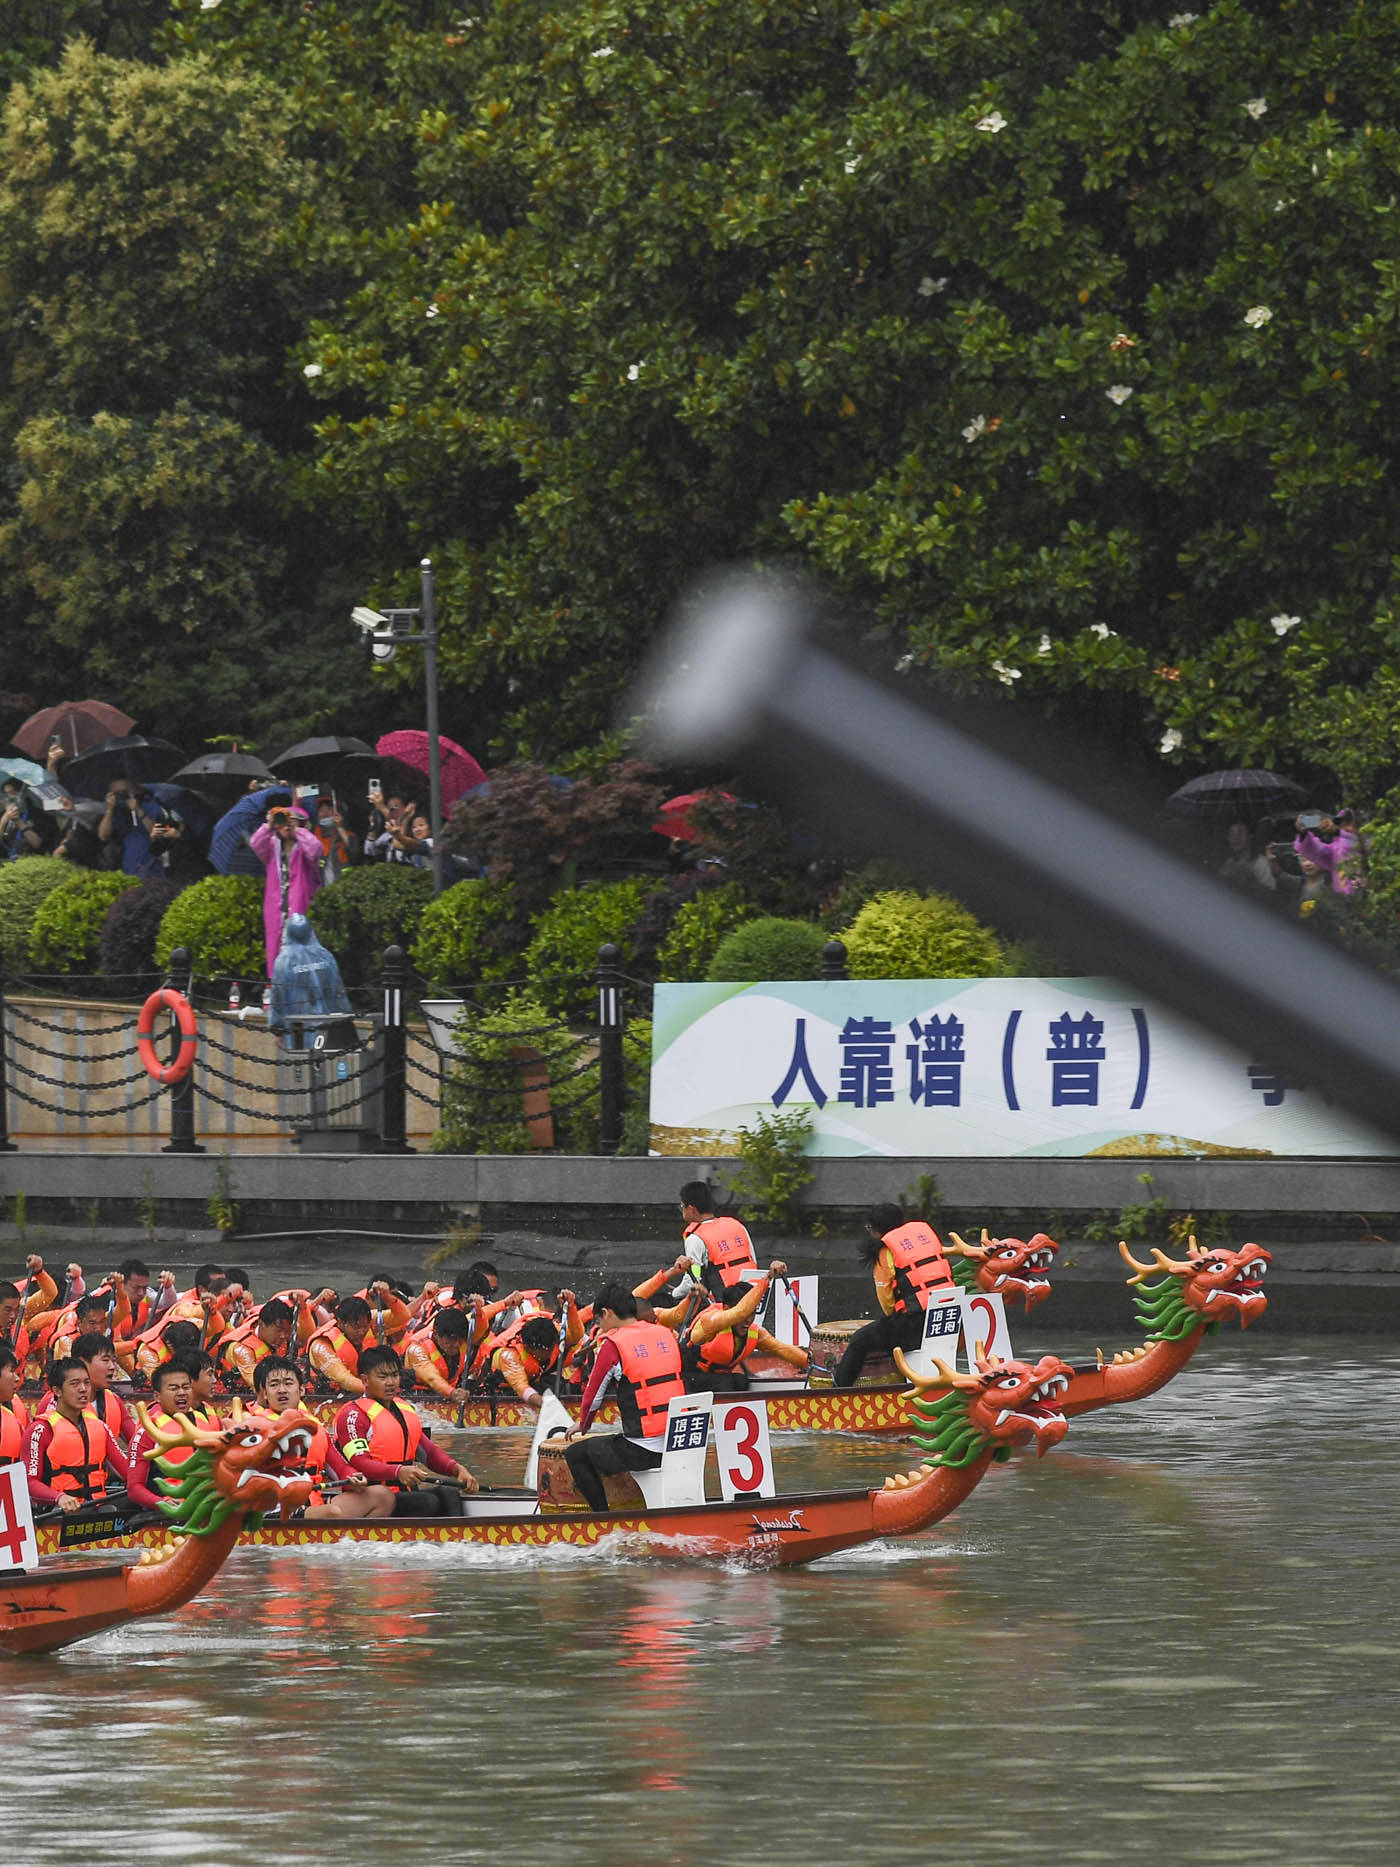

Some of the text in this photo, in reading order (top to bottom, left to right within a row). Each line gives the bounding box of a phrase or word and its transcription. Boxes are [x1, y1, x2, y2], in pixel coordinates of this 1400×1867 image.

[717, 1234, 745, 1252] 培生
[899, 1233, 931, 1252] 培生
[785, 1280, 800, 1345] 1
[932, 1308, 959, 1322] 培生
[930, 1320, 956, 1335] 龙舟
[970, 1298, 1004, 1362] 2
[634, 1340, 671, 1359] 培生
[674, 1416, 705, 1433] 培生
[671, 1431, 702, 1448] 龙舟
[724, 1406, 764, 1492] 3
